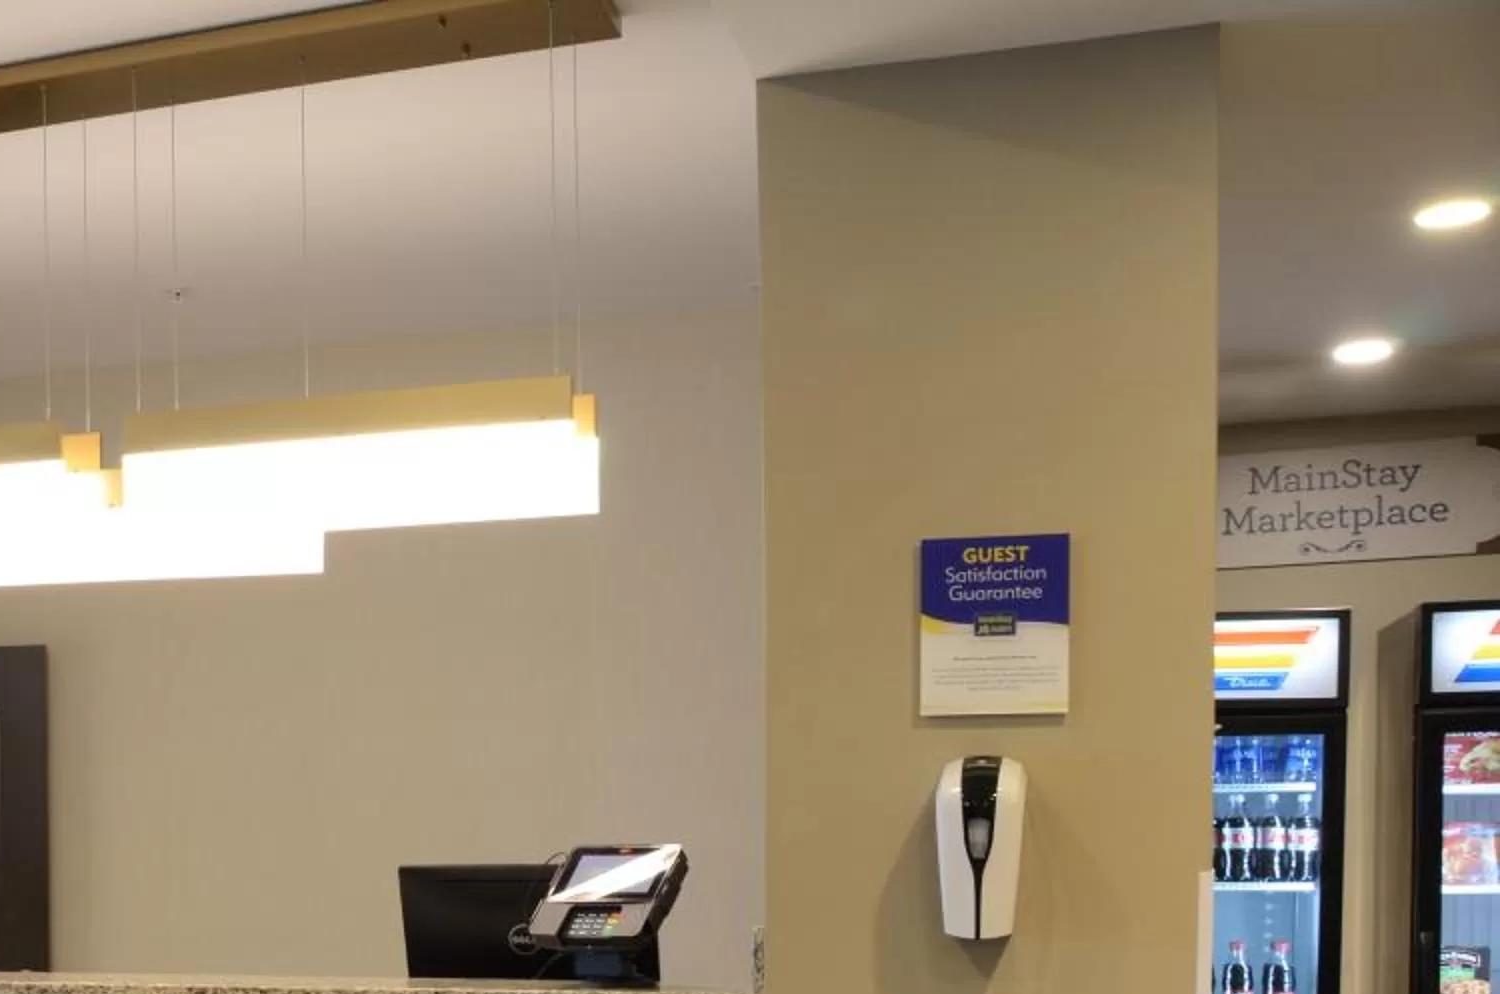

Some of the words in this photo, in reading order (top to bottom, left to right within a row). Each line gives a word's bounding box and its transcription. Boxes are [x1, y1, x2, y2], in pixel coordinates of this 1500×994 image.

[1247, 459, 1422, 496] MainStay
[1221, 495, 1449, 536] Marketplace
[963, 545, 1031, 565] GUEST
[945, 565, 1047, 584] Satisfaction
[949, 585, 1044, 602] Guarantee
